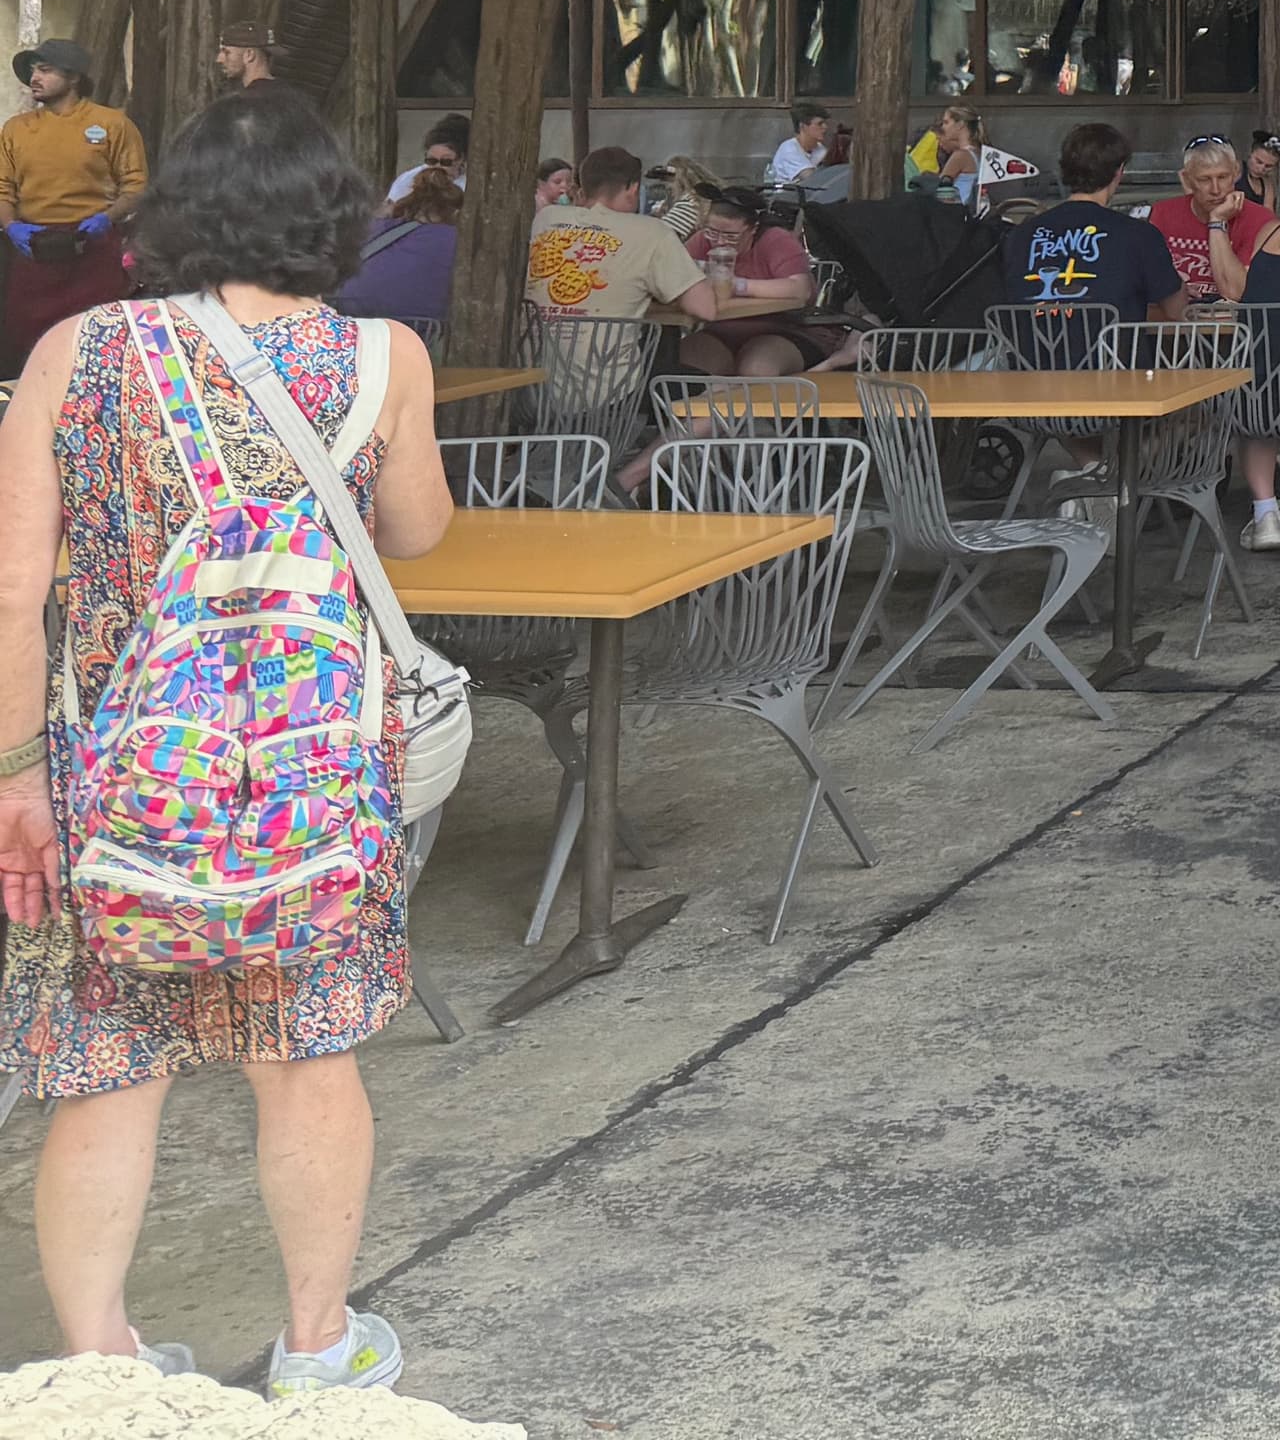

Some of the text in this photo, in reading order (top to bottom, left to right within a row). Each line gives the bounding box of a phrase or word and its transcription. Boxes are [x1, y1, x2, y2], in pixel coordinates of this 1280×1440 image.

[1033, 226, 1054, 238] ST.
[1028, 225, 1108, 271] FRANCIS
[256, 673, 285, 688] LUG
